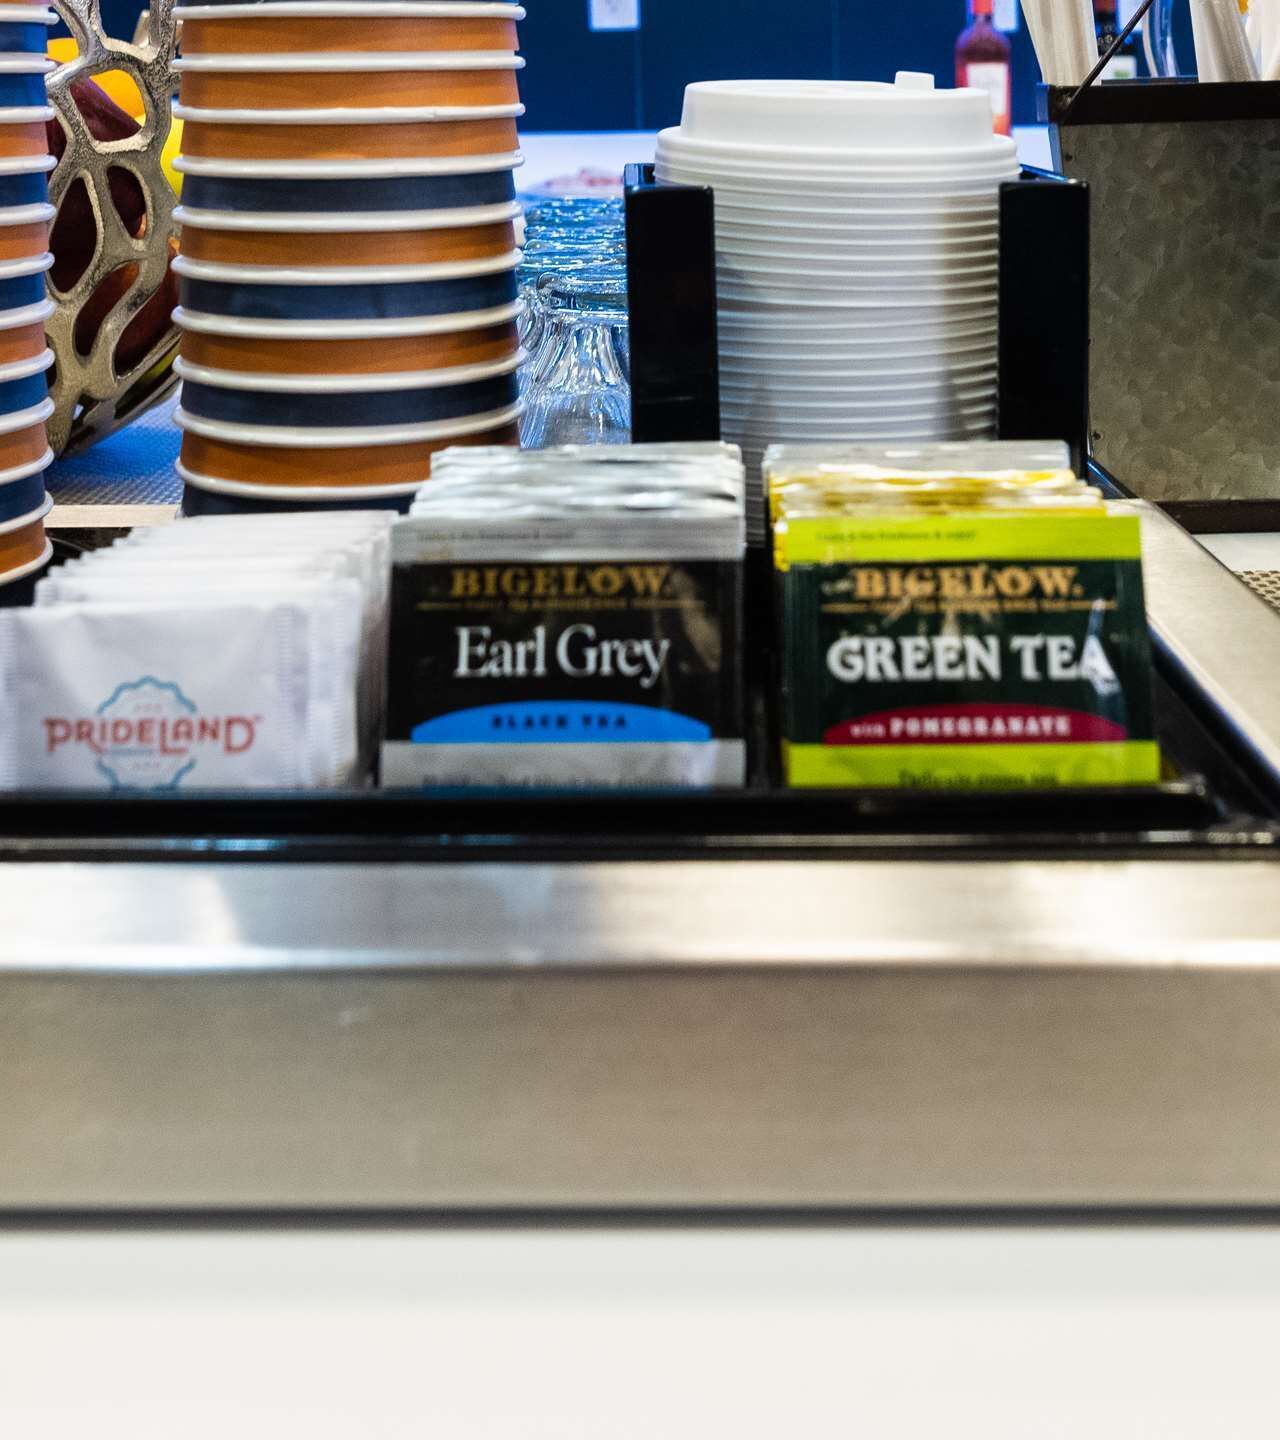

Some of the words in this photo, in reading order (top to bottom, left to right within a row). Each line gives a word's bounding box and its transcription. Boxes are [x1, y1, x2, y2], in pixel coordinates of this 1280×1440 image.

[450, 563, 670, 598] BIGELOW
[453, 623, 548, 679] Earl
[556, 623, 671, 689] Grey
[826, 634, 1003, 683] GREEN
[1009, 633, 1117, 683] TEA
[492, 714, 568, 730] BLACK
[581, 714, 627, 730] TEA
[850, 722, 886, 738] with
[890, 716, 1070, 738] POMEGRANATE
